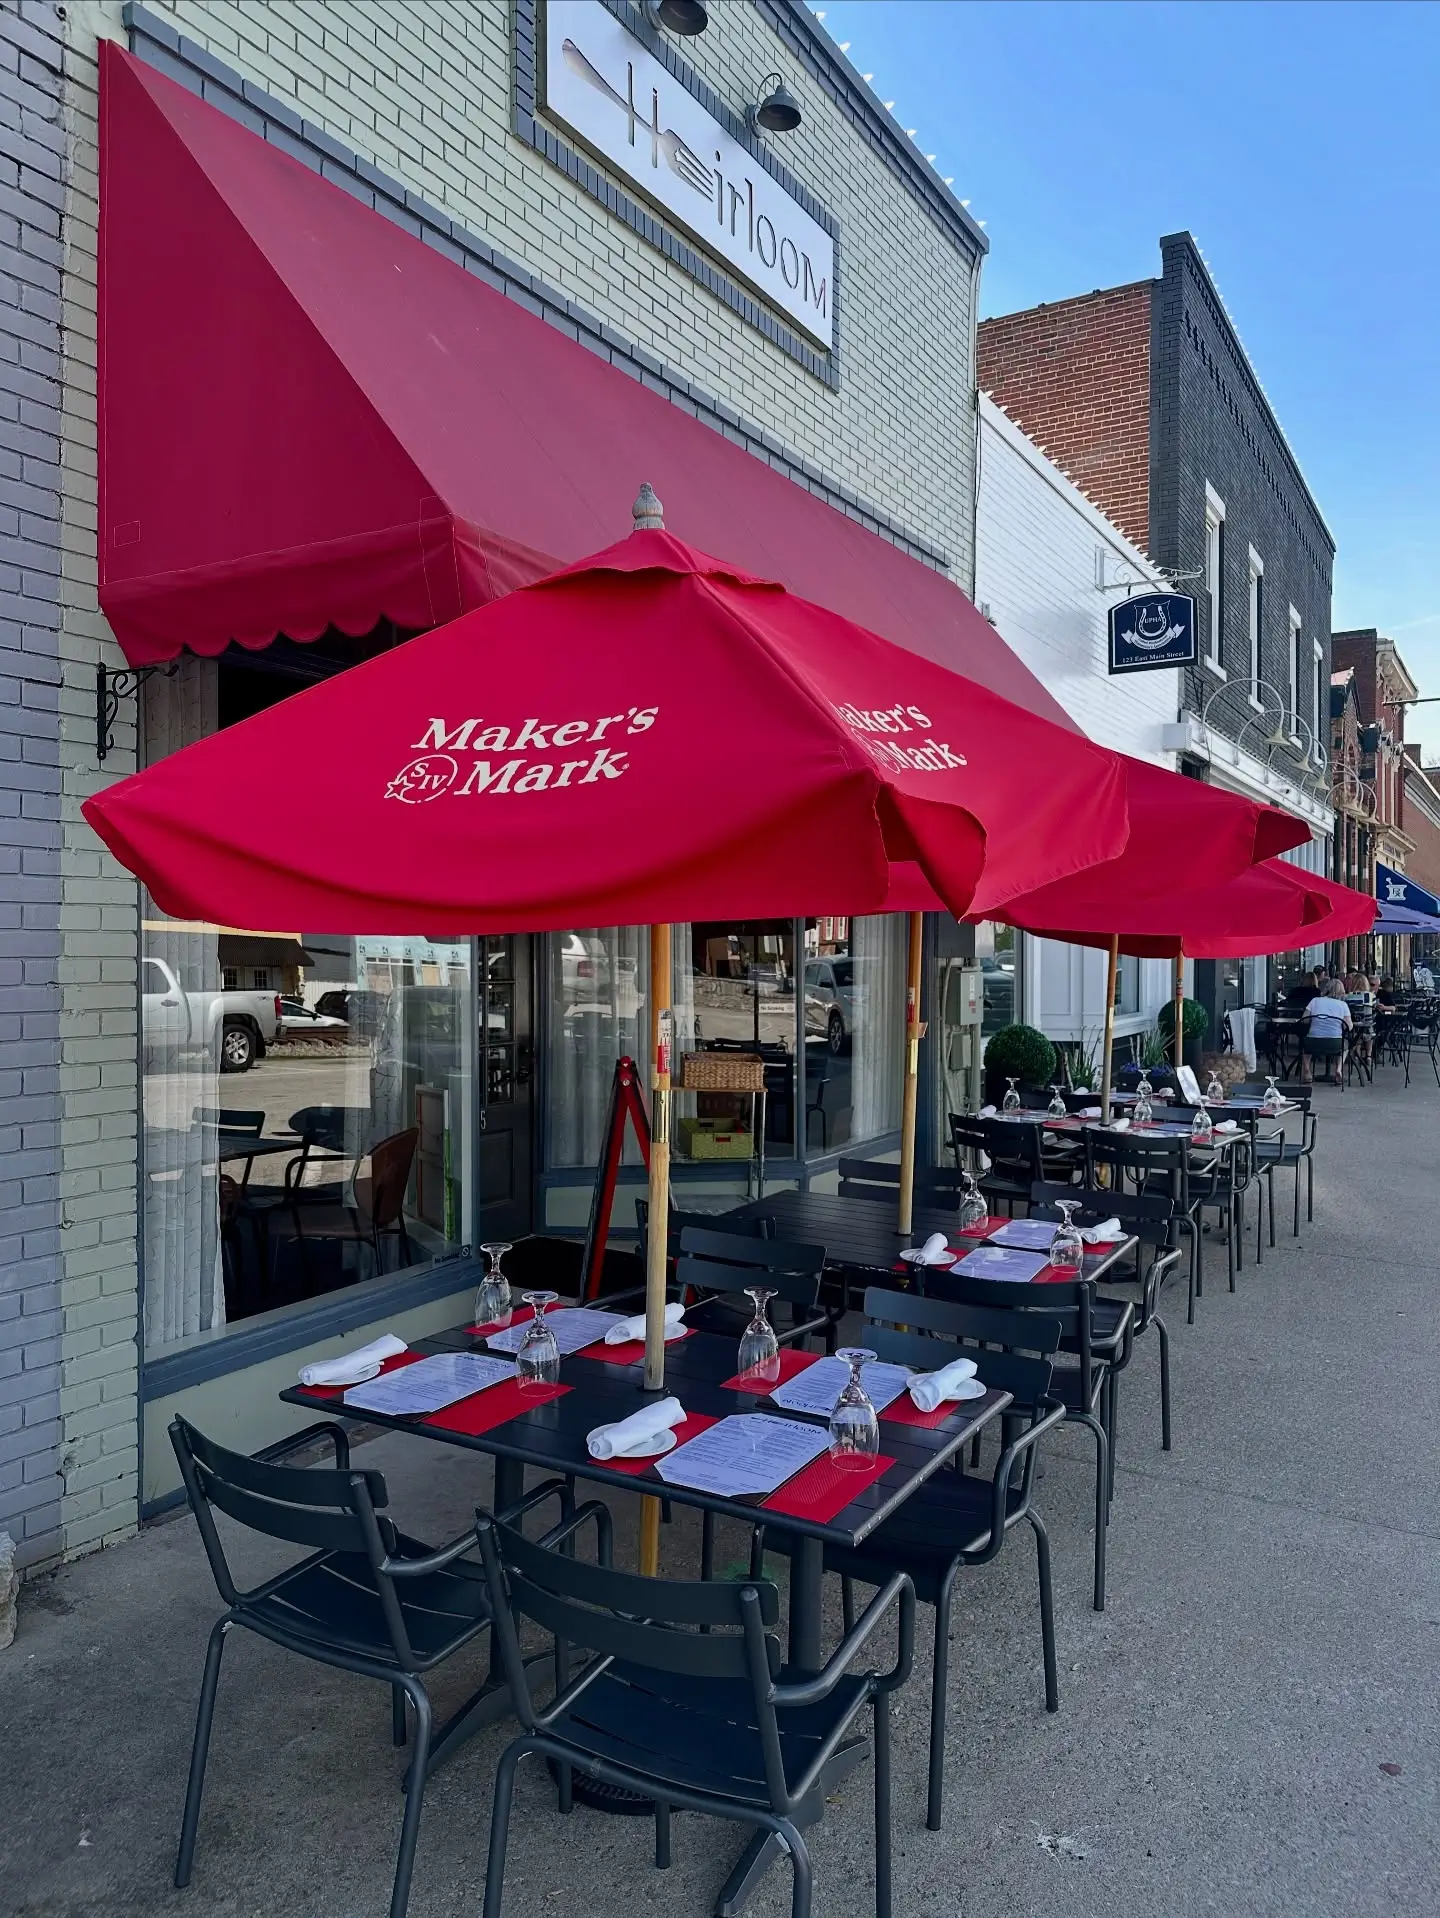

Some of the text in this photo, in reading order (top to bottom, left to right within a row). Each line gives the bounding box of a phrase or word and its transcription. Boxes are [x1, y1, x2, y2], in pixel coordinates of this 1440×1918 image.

[1134, 654, 1148, 662] East
[1149, 653, 1165, 661] Main
[1166, 651, 1184, 659] Street
[410, 705, 660, 752] Maker's
[835, 702, 932, 734] aker's
[454, 747, 629, 796] Mark
